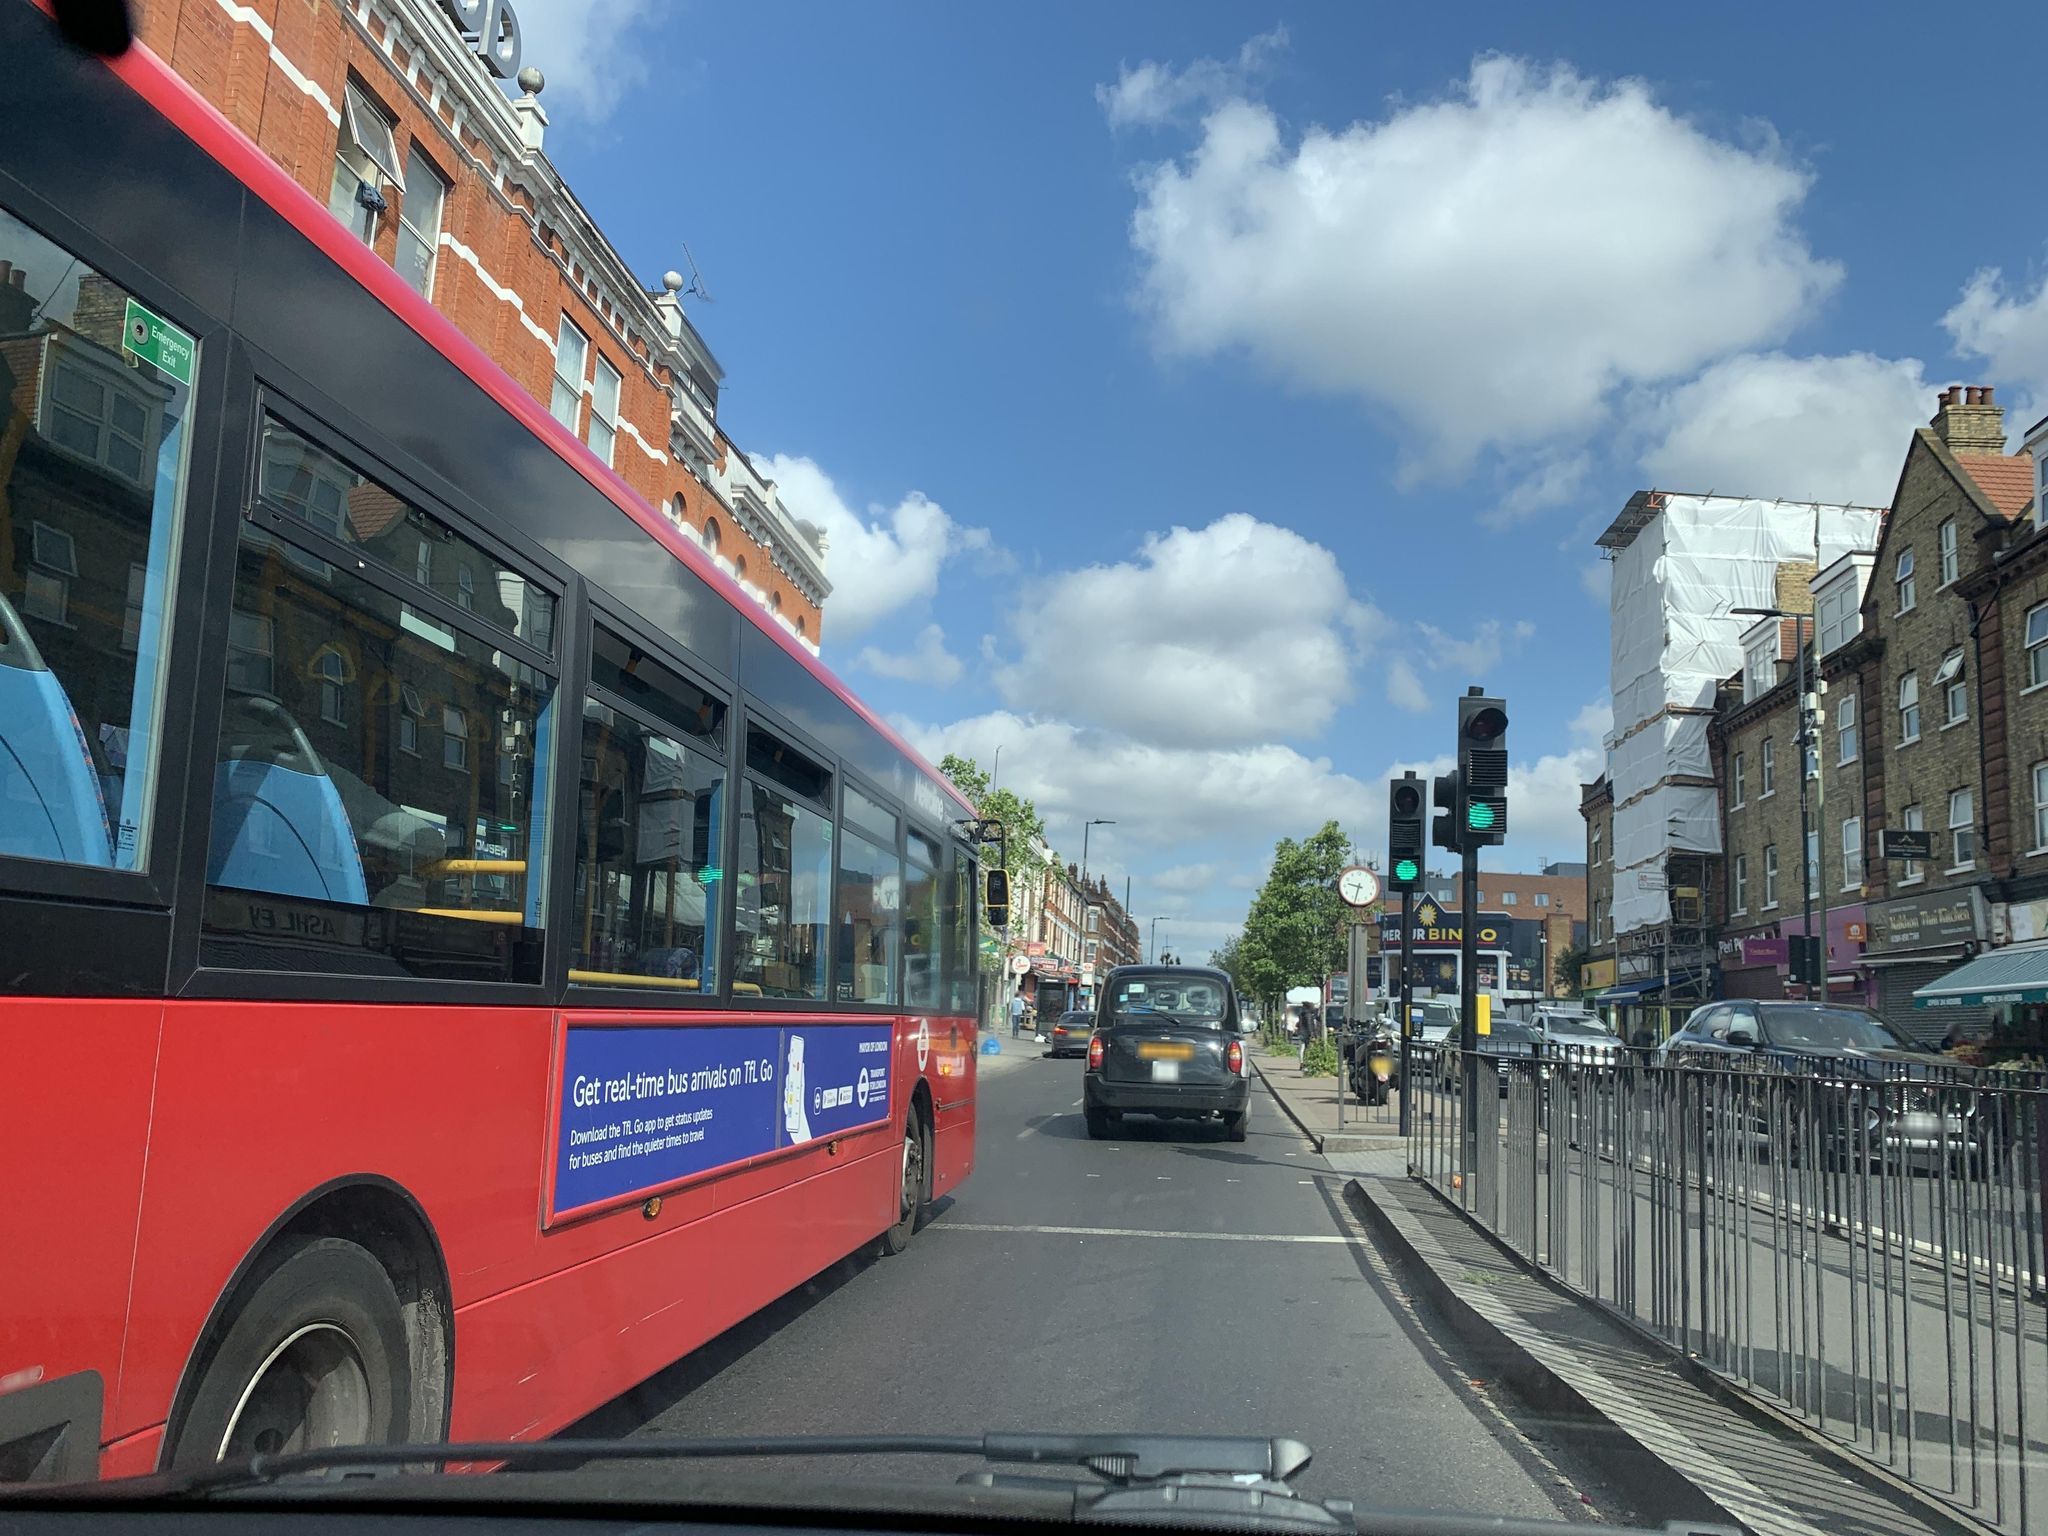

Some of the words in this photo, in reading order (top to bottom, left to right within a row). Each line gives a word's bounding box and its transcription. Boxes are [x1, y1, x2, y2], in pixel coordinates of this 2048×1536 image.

[152, 326, 190, 361] Emergency
[162, 350, 176, 368] Exit
[1382, 928, 1425, 941] MERUR
[1428, 928, 1497, 941] BINO
[859, 1042, 870, 1053] MAYOR
[875, 1041, 888, 1052] LONDON
[573, 1075, 601, 1108] Get
[604, 1072, 664, 1104] real-time
[667, 1068, 687, 1095] bus
[691, 1063, 726, 1092] arrivals
[729, 1067, 741, 1087] on
[744, 1060, 758, 1084] TfL
[760, 1059, 773, 1082] Go
[570, 1125, 607, 1146] Download
[609, 1123, 621, 1139] the
[622, 1121, 633, 1136] TfL
[633, 1118, 644, 1134] Go
[645, 1119, 656, 1135] app
[657, 1116, 664, 1129] to
[664, 1115, 675, 1131] get
[675, 1111, 692, 1127] status
[692, 1108, 713, 1126] updates
[569, 1153, 581, 1170] for
[581, 1150, 603, 1168] buses
[603, 1146, 618, 1163] and
[618, 1143, 631, 1159] find
[631, 1141, 643, 1156] the
[644, 1136, 665, 1157] quieter
[665, 1132, 682, 1149] times
[682, 1130, 689, 1144] to
[689, 1127, 705, 1143] travel
